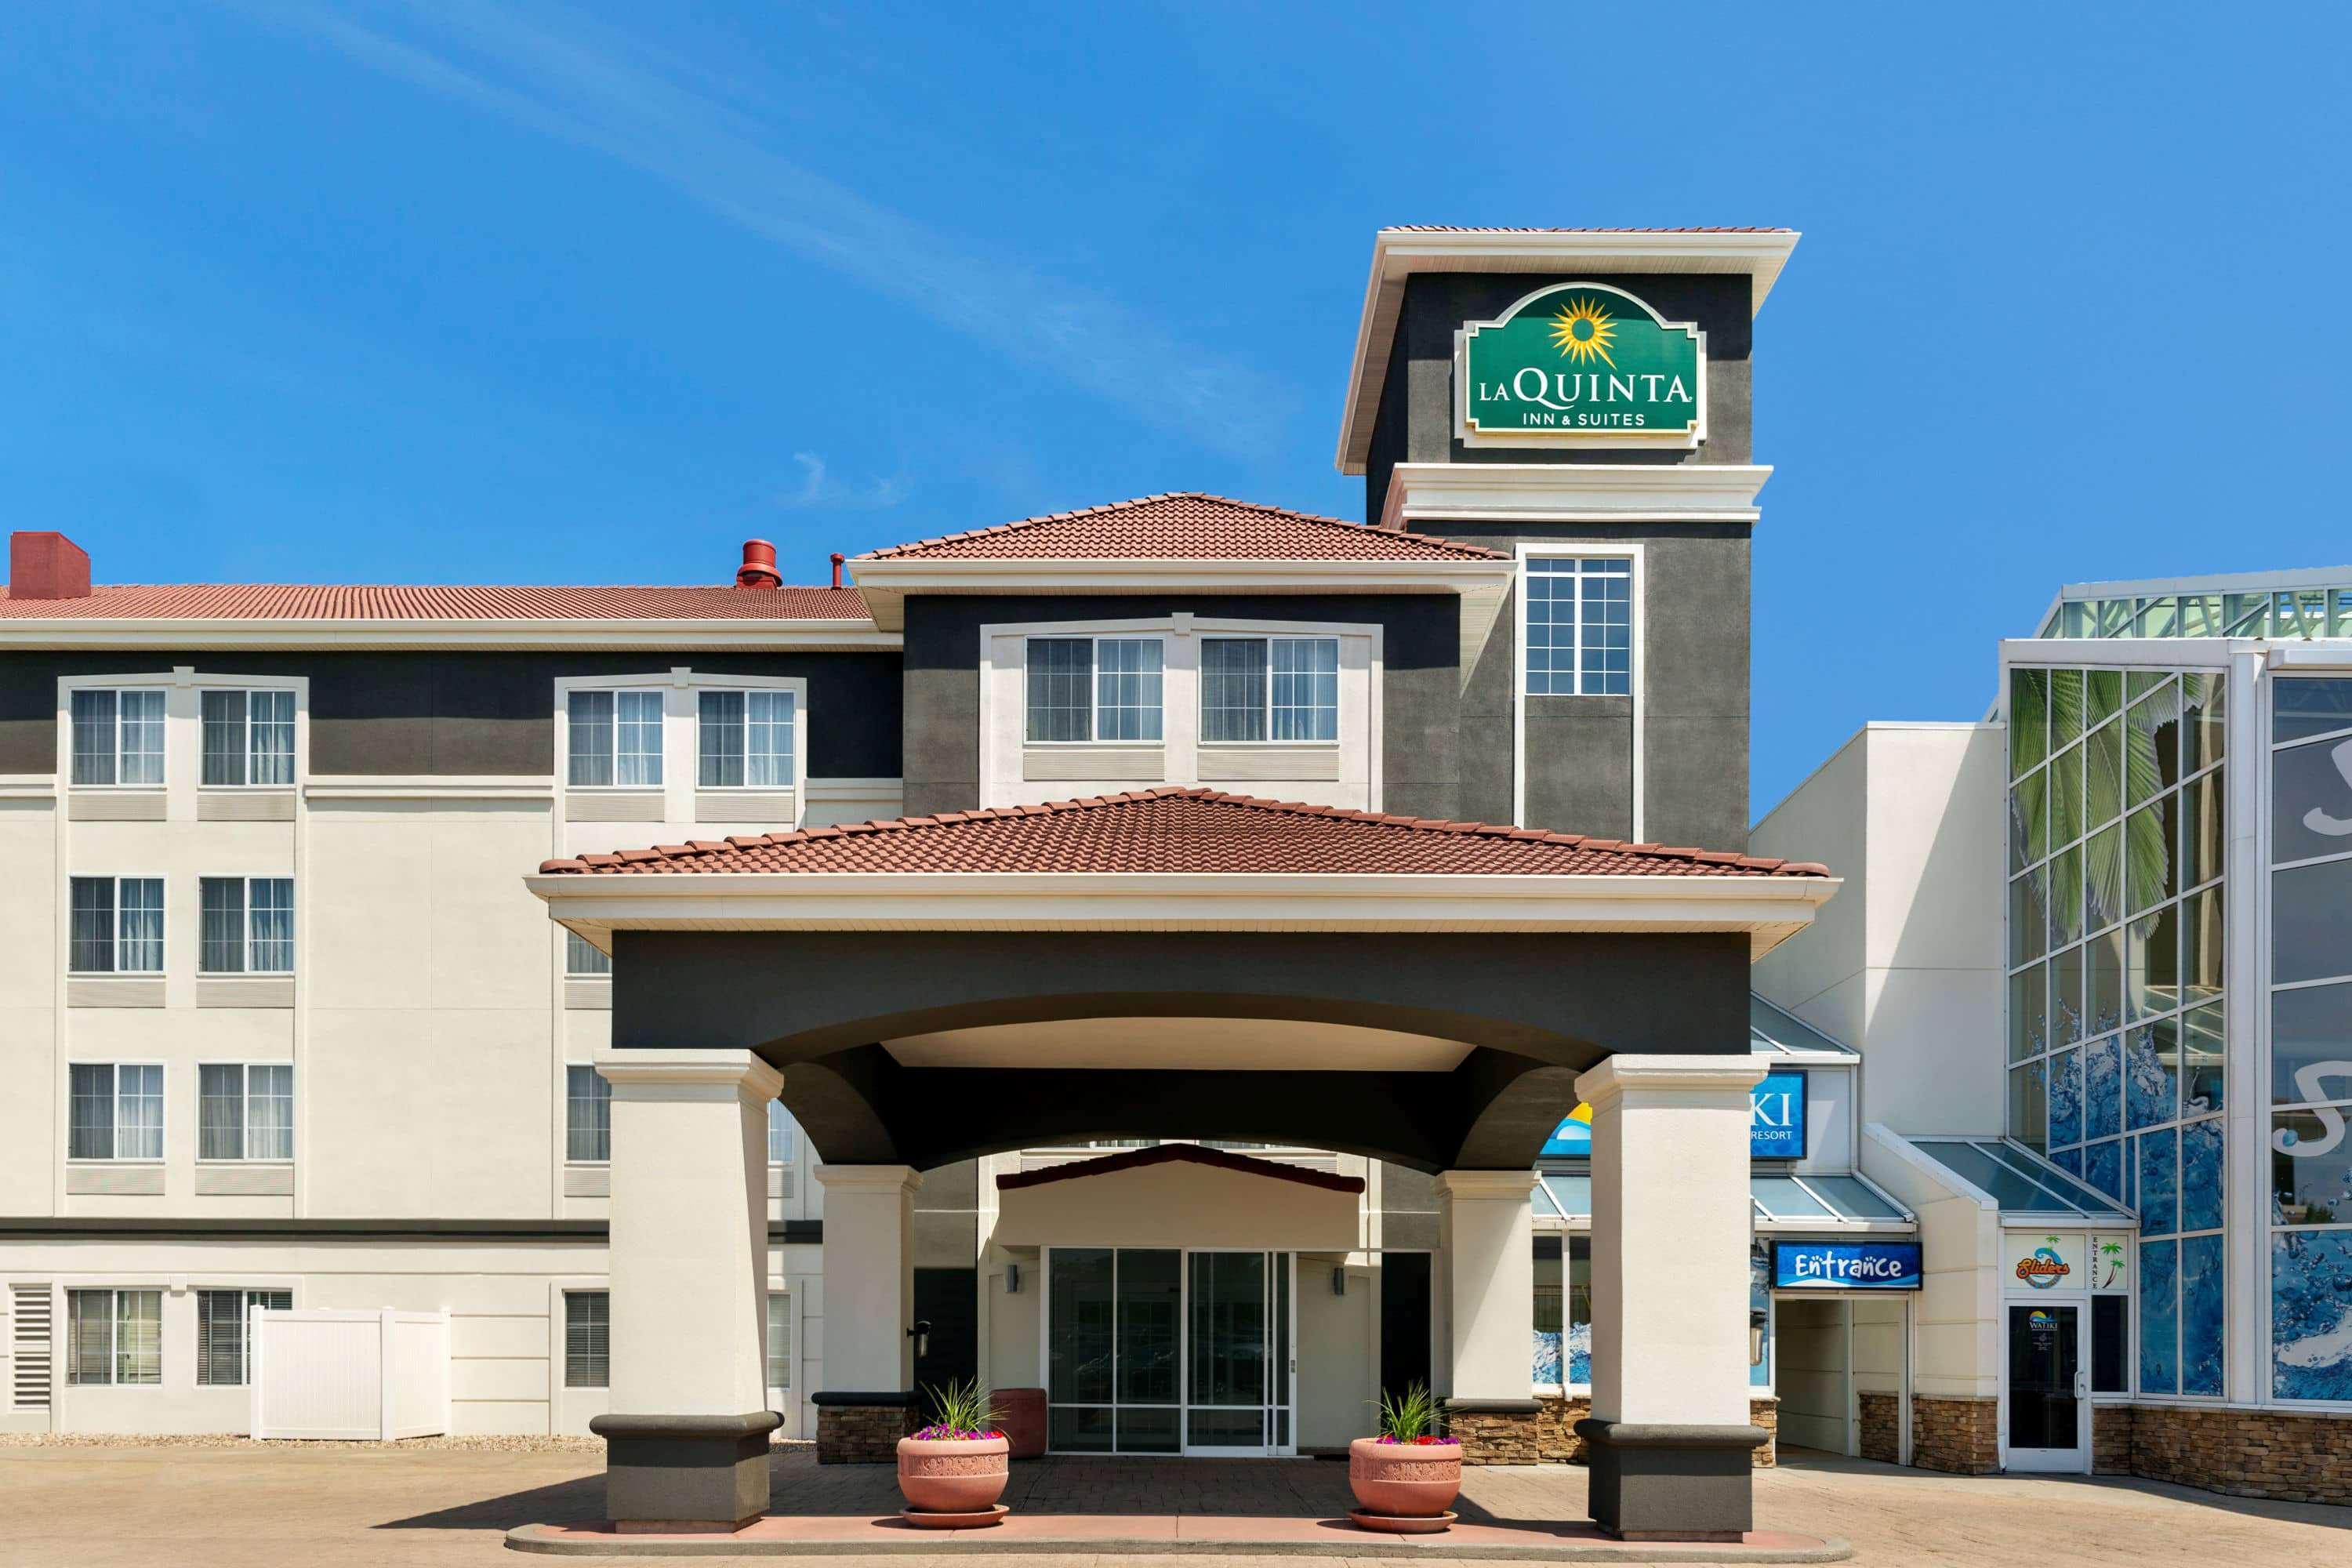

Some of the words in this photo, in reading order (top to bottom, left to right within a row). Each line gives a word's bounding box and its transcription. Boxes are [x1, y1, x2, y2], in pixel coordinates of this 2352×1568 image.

[1479, 383, 1510, 401] LA
[1513, 367, 1690, 410] QUINTA
[1523, 413, 1555, 425] INN
[1562, 415, 1570, 425] &
[1578, 414, 1645, 426] SUITES
[1751, 1131, 1792, 1140] RESORT
[1795, 1250, 1902, 1279] Entrance
[2016, 1258, 2070, 1279] Sliders
